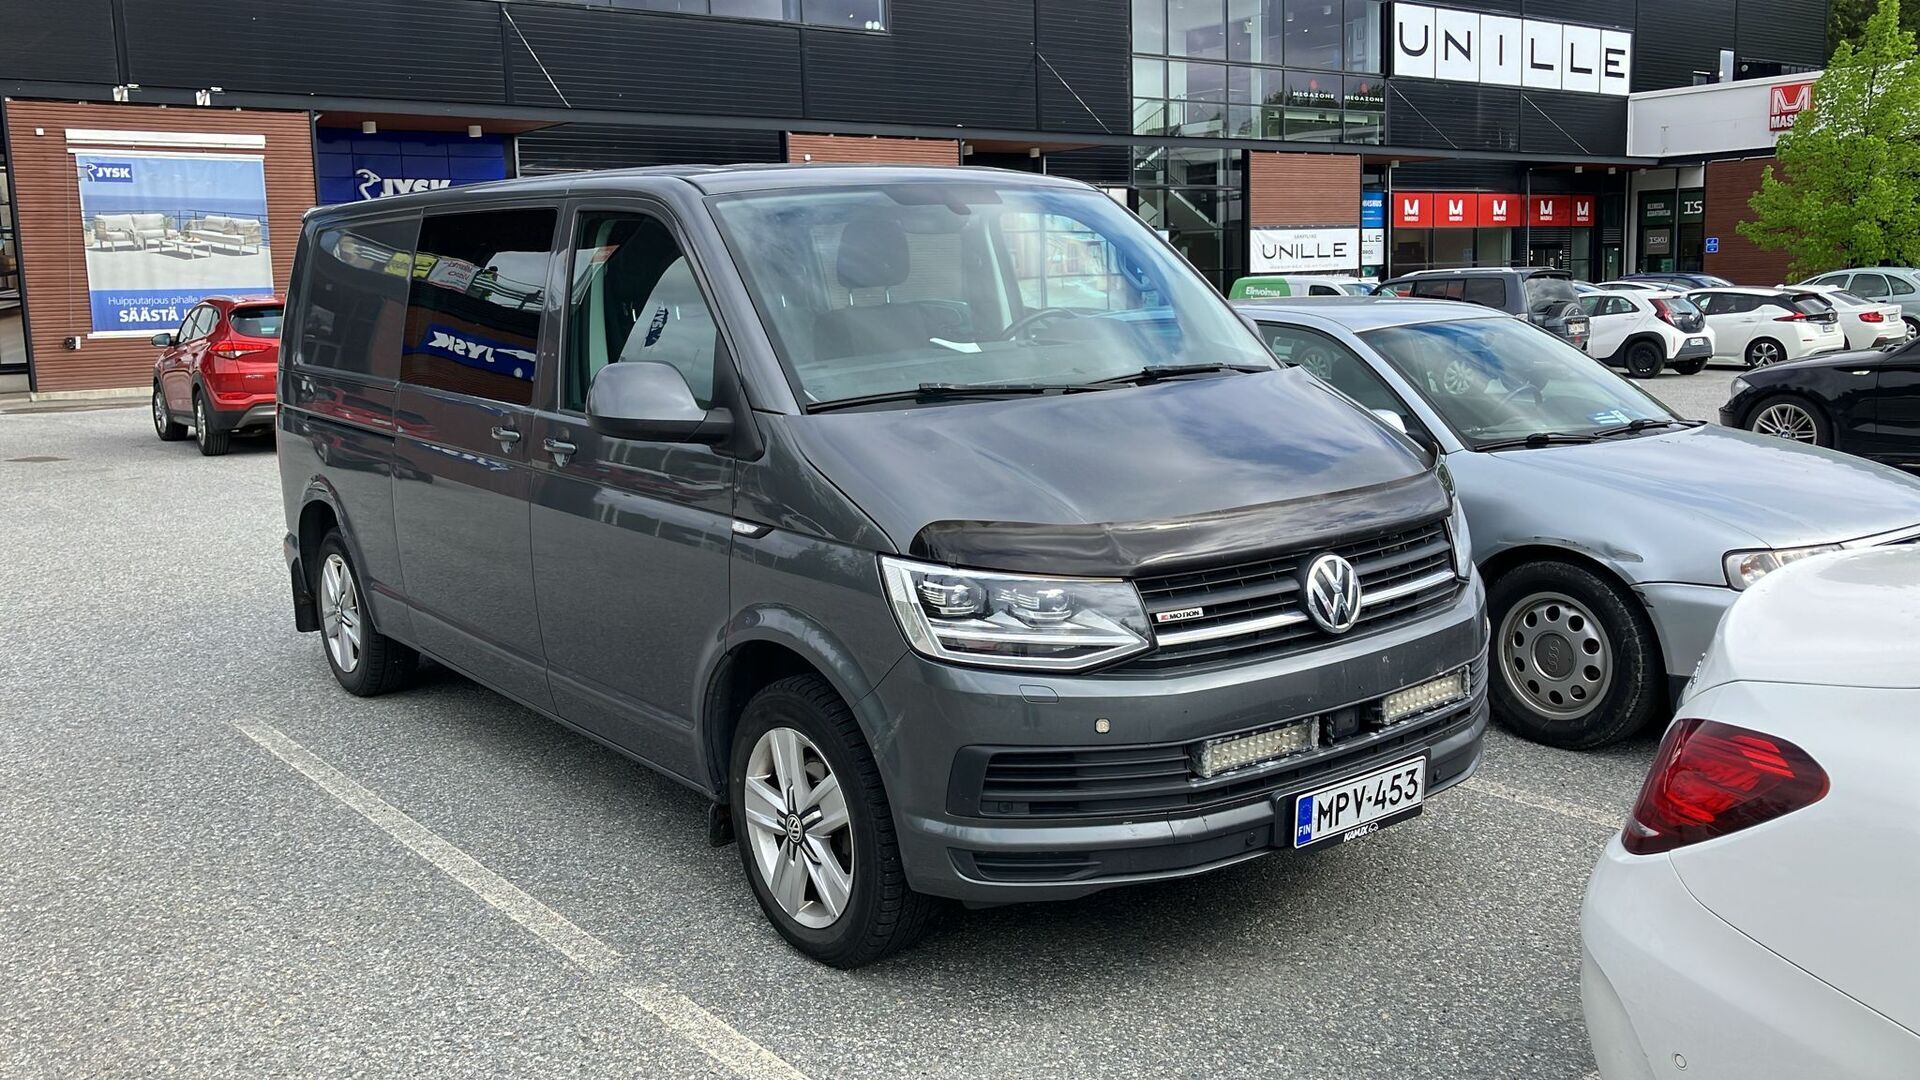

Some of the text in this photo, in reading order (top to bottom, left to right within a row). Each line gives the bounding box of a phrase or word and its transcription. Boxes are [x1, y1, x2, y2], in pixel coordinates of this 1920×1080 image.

[1399, 21, 1626, 79] UNILLE
[1292, 91, 1335, 99] MEGAZONE
[1344, 95, 1384, 103] MEGAZONE
[96, 167, 131, 178] JYSK
[1262, 243, 1347, 259] UNILLE
[108, 296, 169, 306] Huipputarjous
[171, 295, 199, 306] pihalle
[119, 307, 179, 323] SÄÄSTÄ
[1317, 768, 1419, 832] MPV-453
[1298, 823, 1312, 837] FIN
